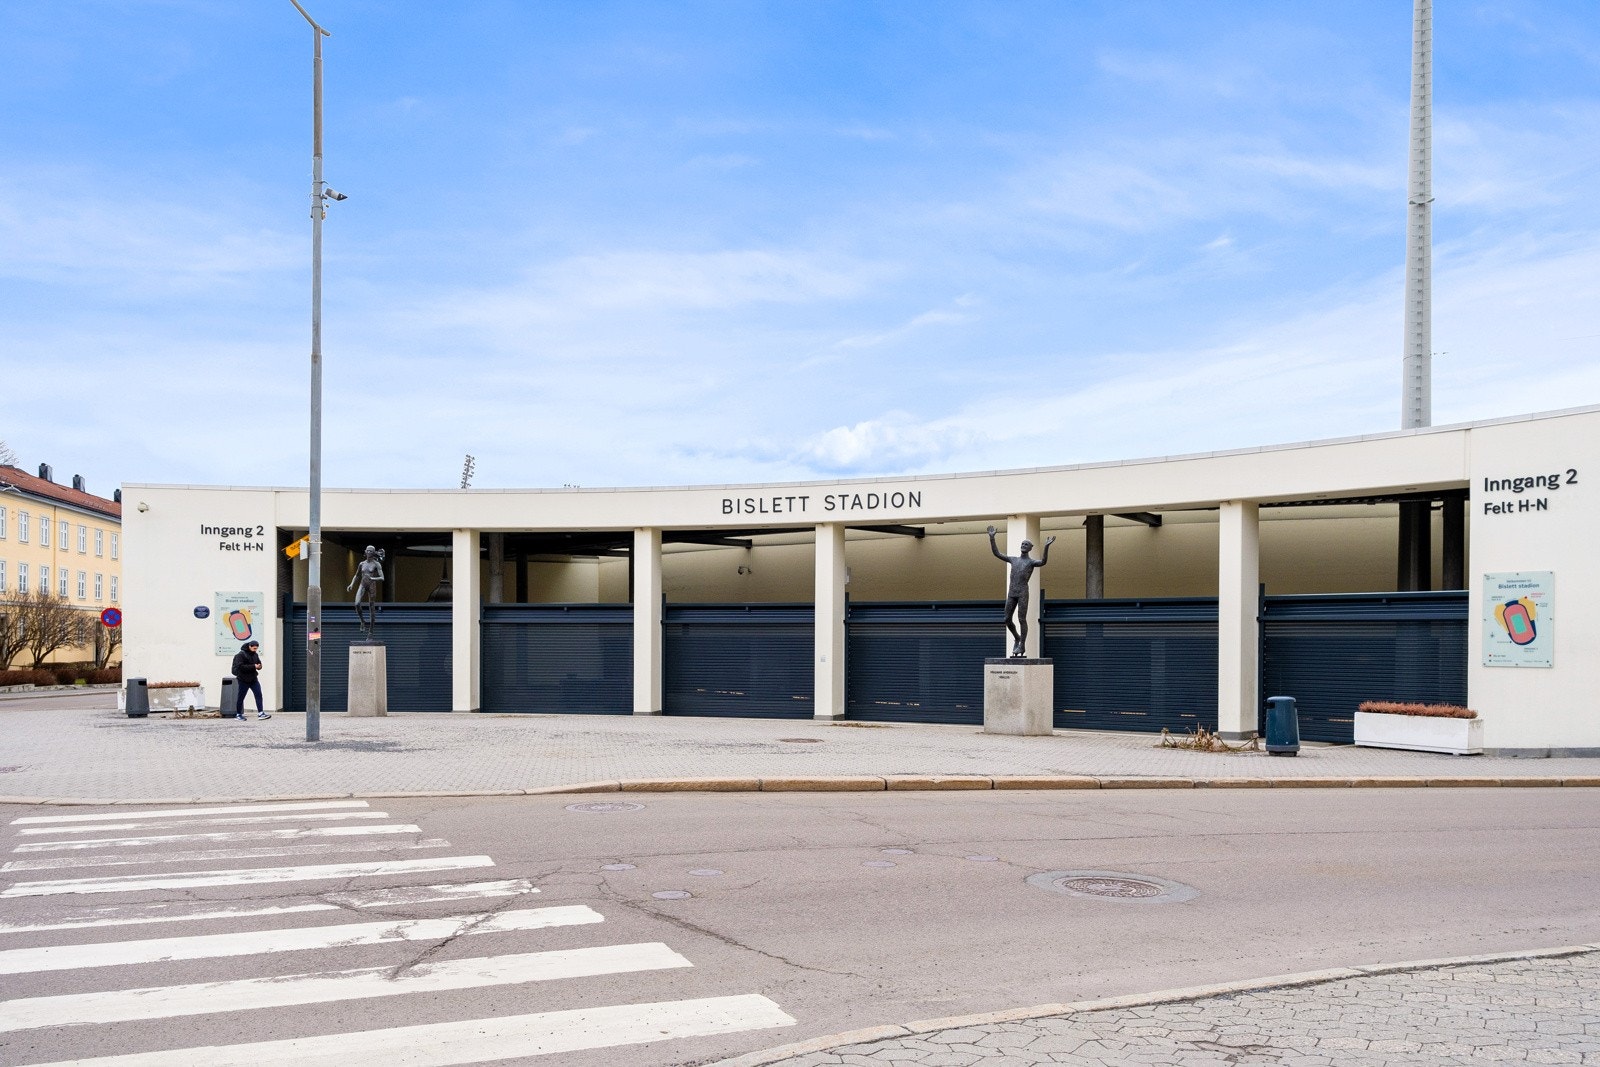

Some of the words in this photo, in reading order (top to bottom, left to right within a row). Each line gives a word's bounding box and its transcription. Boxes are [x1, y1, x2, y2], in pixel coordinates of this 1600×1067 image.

[1484, 473, 1560, 493] Inngang
[1565, 468, 1578, 485] 2
[722, 495, 810, 514] BISLETT
[824, 491, 922, 511] STADION
[1484, 501, 1514, 515] Felt
[1518, 497, 1548, 512] H-N
[200, 524, 253, 538] Inngang
[256, 525, 264, 536] 2
[219, 541, 241, 551] Felt
[243, 542, 264, 552] H-N
